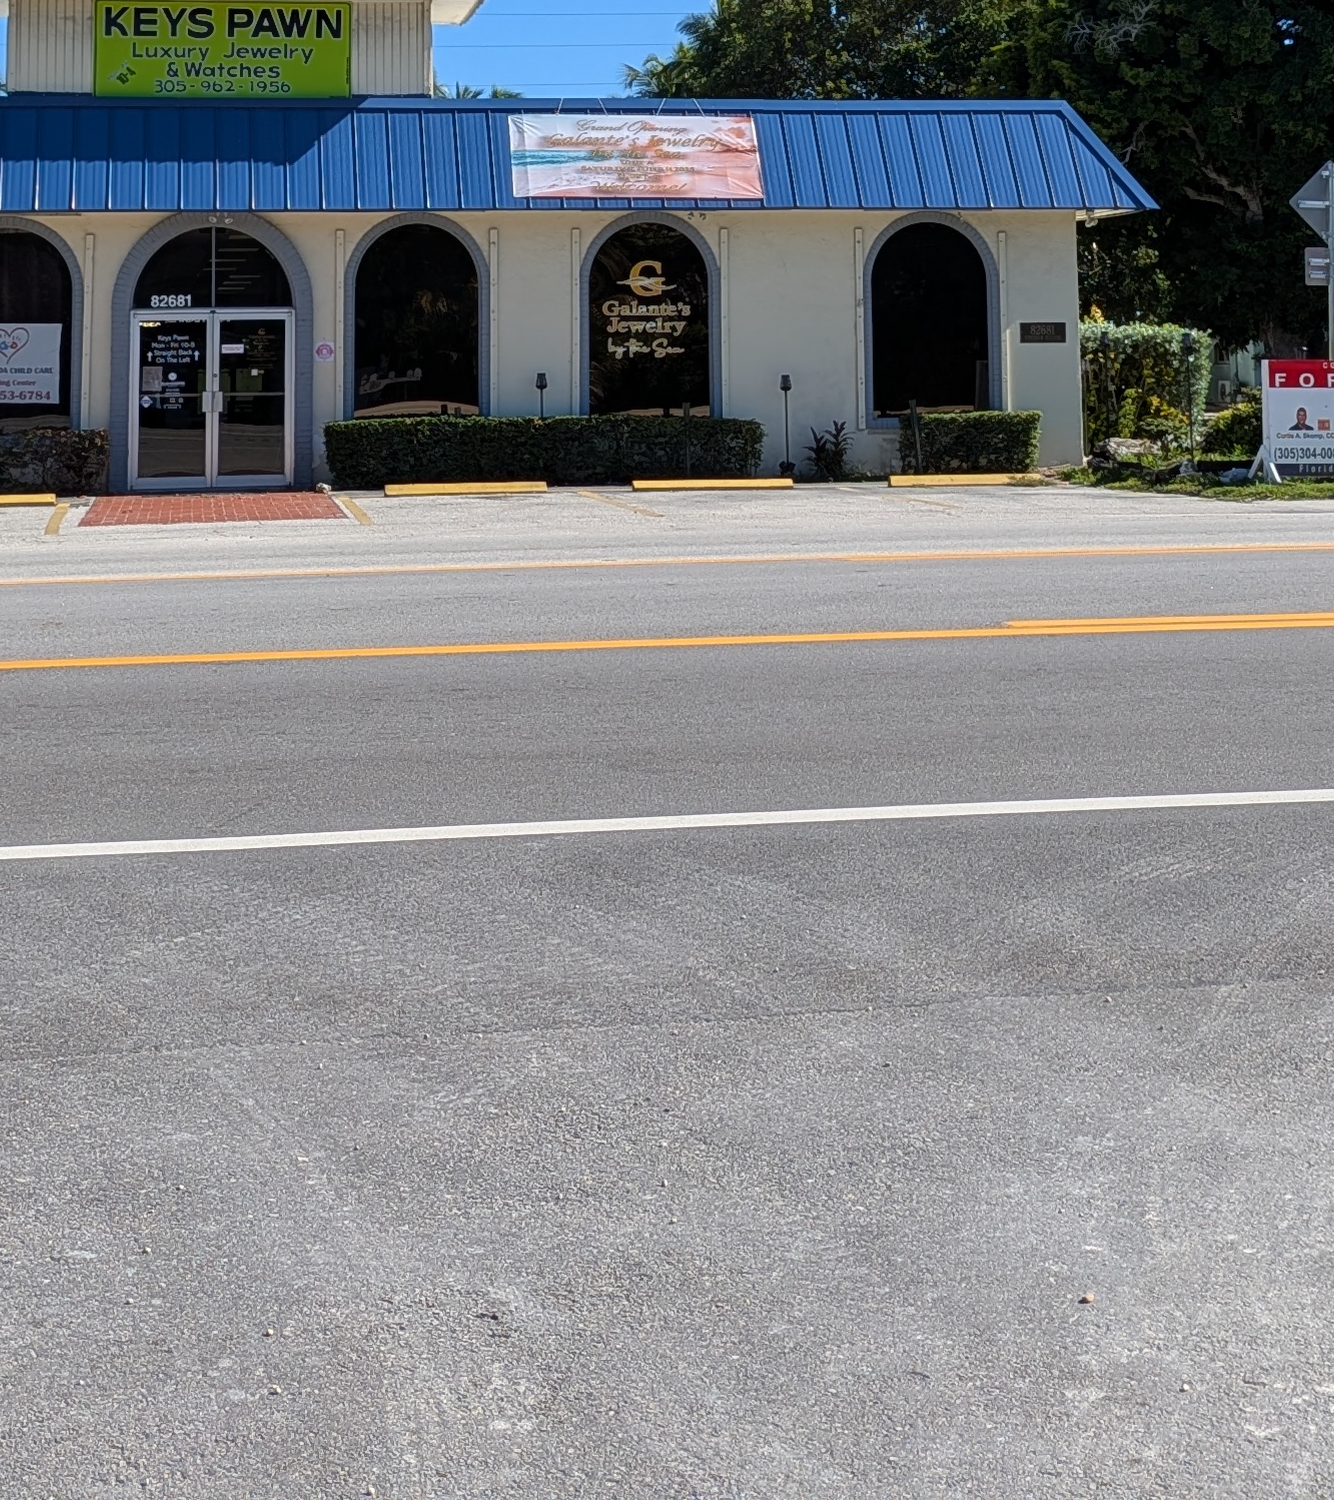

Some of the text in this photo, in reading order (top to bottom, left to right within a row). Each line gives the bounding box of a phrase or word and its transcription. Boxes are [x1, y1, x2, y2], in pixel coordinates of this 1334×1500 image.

[103, 6, 343, 39] KEYS PAWN
[131, 41, 315, 64] Luxury Jewelry
[166, 62, 281, 79] & Watches
[576, 119, 628, 132] Grand
[546, 132, 639, 148] Galante's
[150, 294, 192, 308] 82681
[602, 300, 691, 316] Galante's
[607, 317, 687, 336] Jewelry
[608, 337, 627, 360] by
[652, 338, 686, 359] Sea
